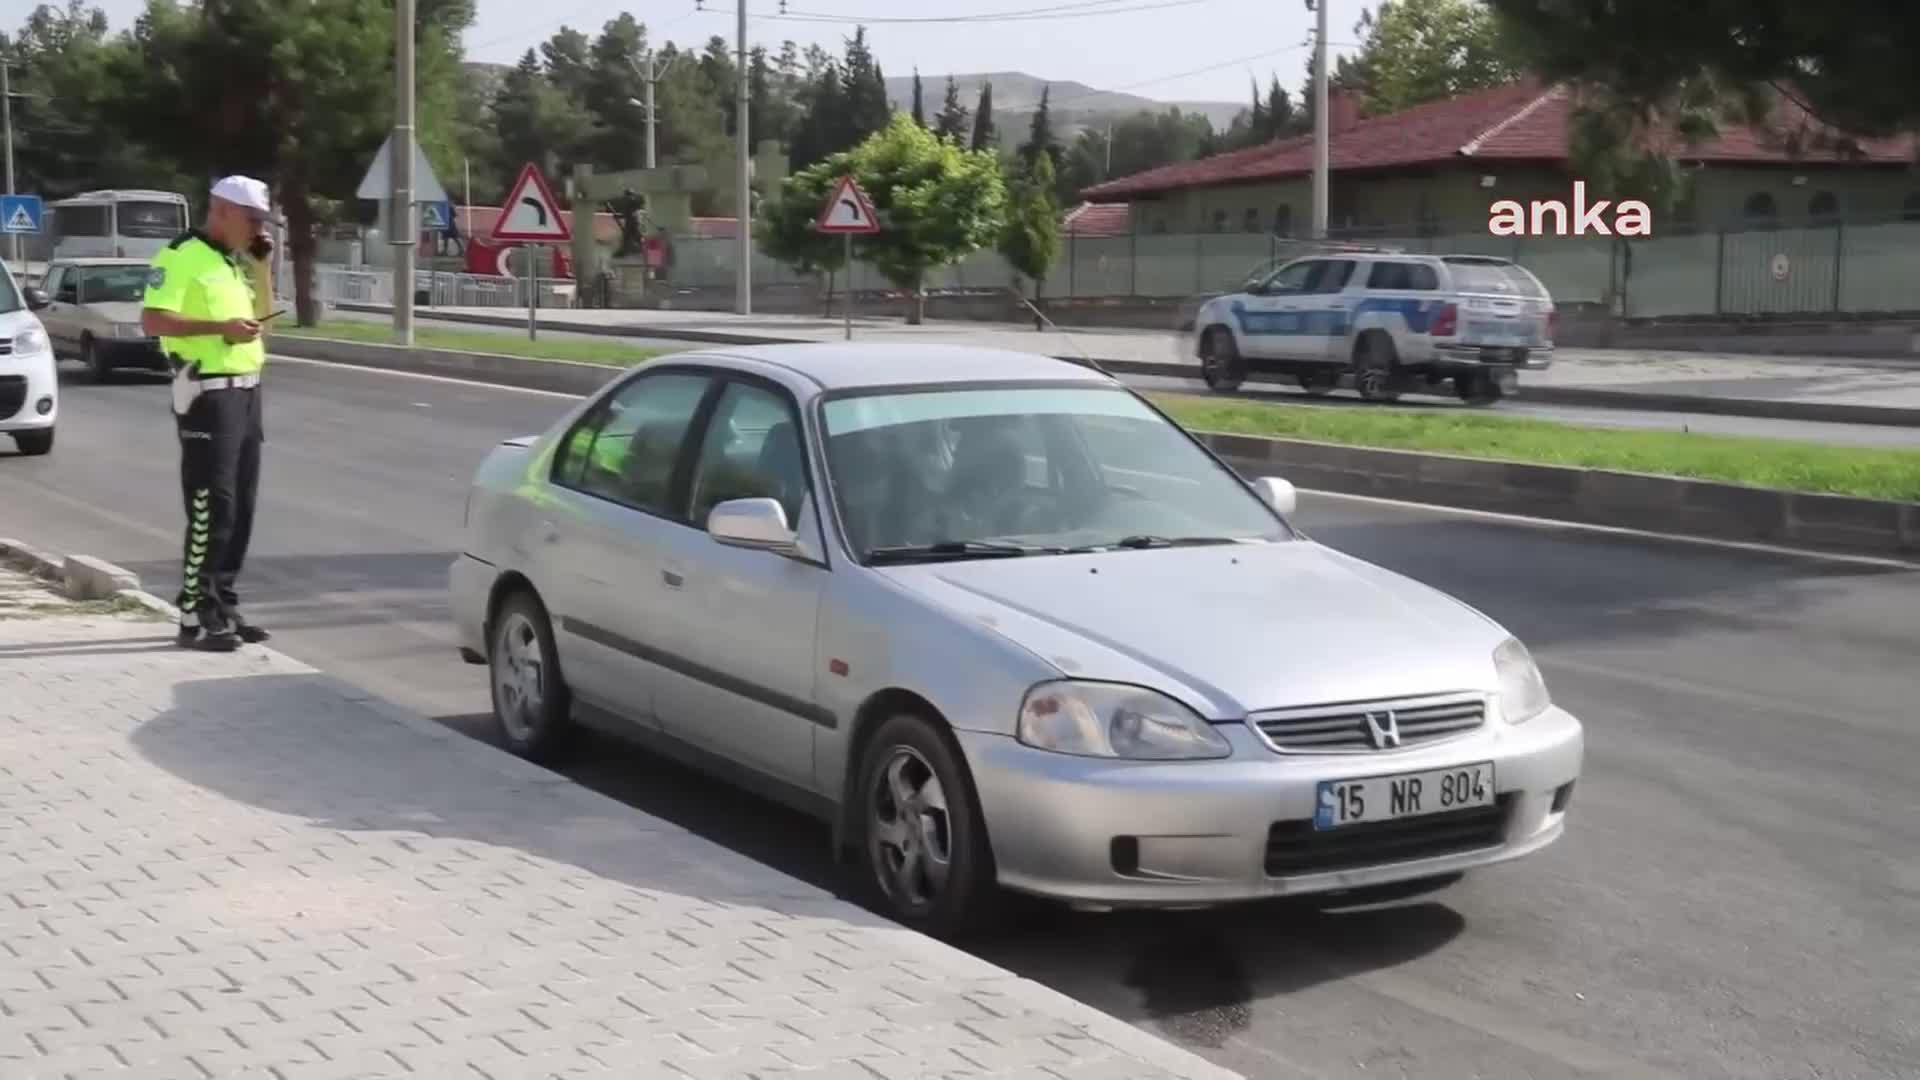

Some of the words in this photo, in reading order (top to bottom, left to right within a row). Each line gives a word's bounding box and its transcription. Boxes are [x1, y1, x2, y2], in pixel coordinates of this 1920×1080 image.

[1337, 784, 1364, 820] 15
[1391, 778, 1422, 815] NR
[1440, 769, 1485, 807] 804
